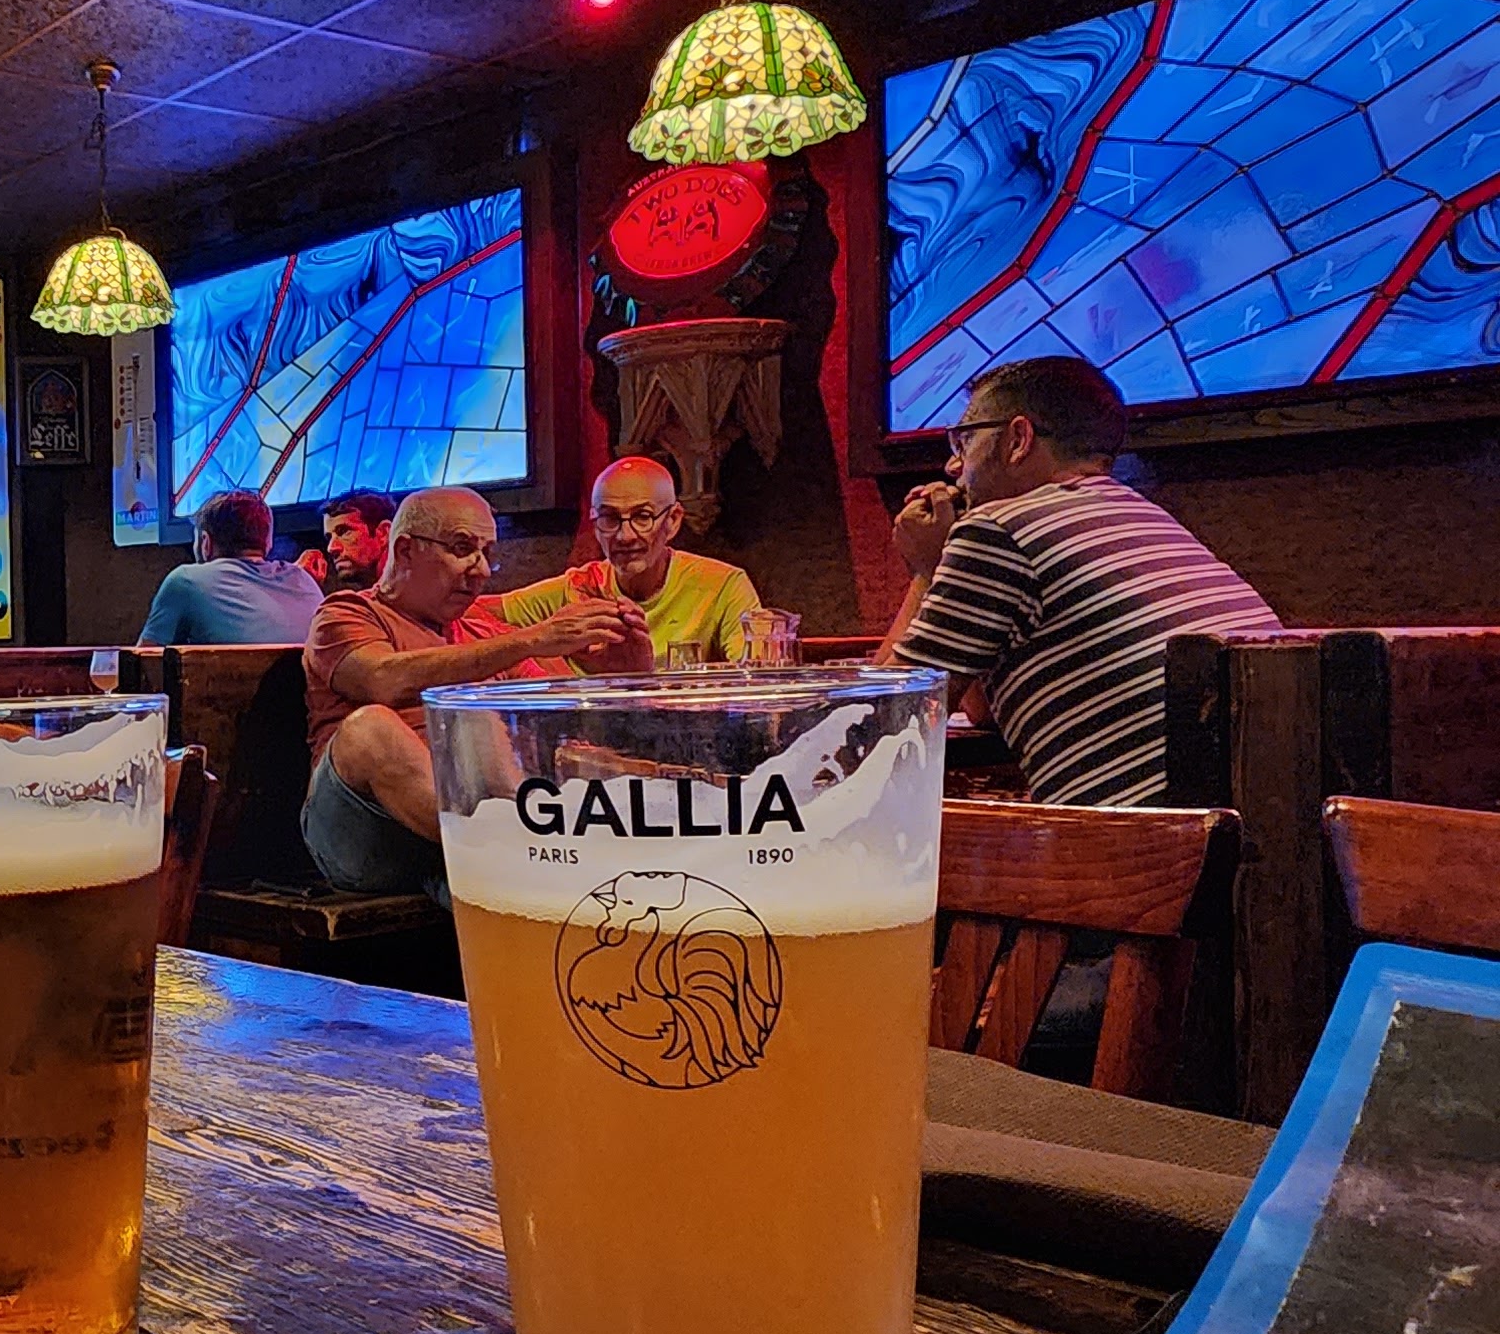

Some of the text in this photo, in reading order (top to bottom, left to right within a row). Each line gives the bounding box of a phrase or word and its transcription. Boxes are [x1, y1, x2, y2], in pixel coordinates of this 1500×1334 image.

[624, 176, 747, 224] TWO DOGS
[29, 423, 77, 449] Leffe
[116, 509, 158, 525] MARTIN
[515, 773, 805, 838] GALLIA
[528, 847, 579, 865] PARIS
[747, 847, 794, 865] 1890
